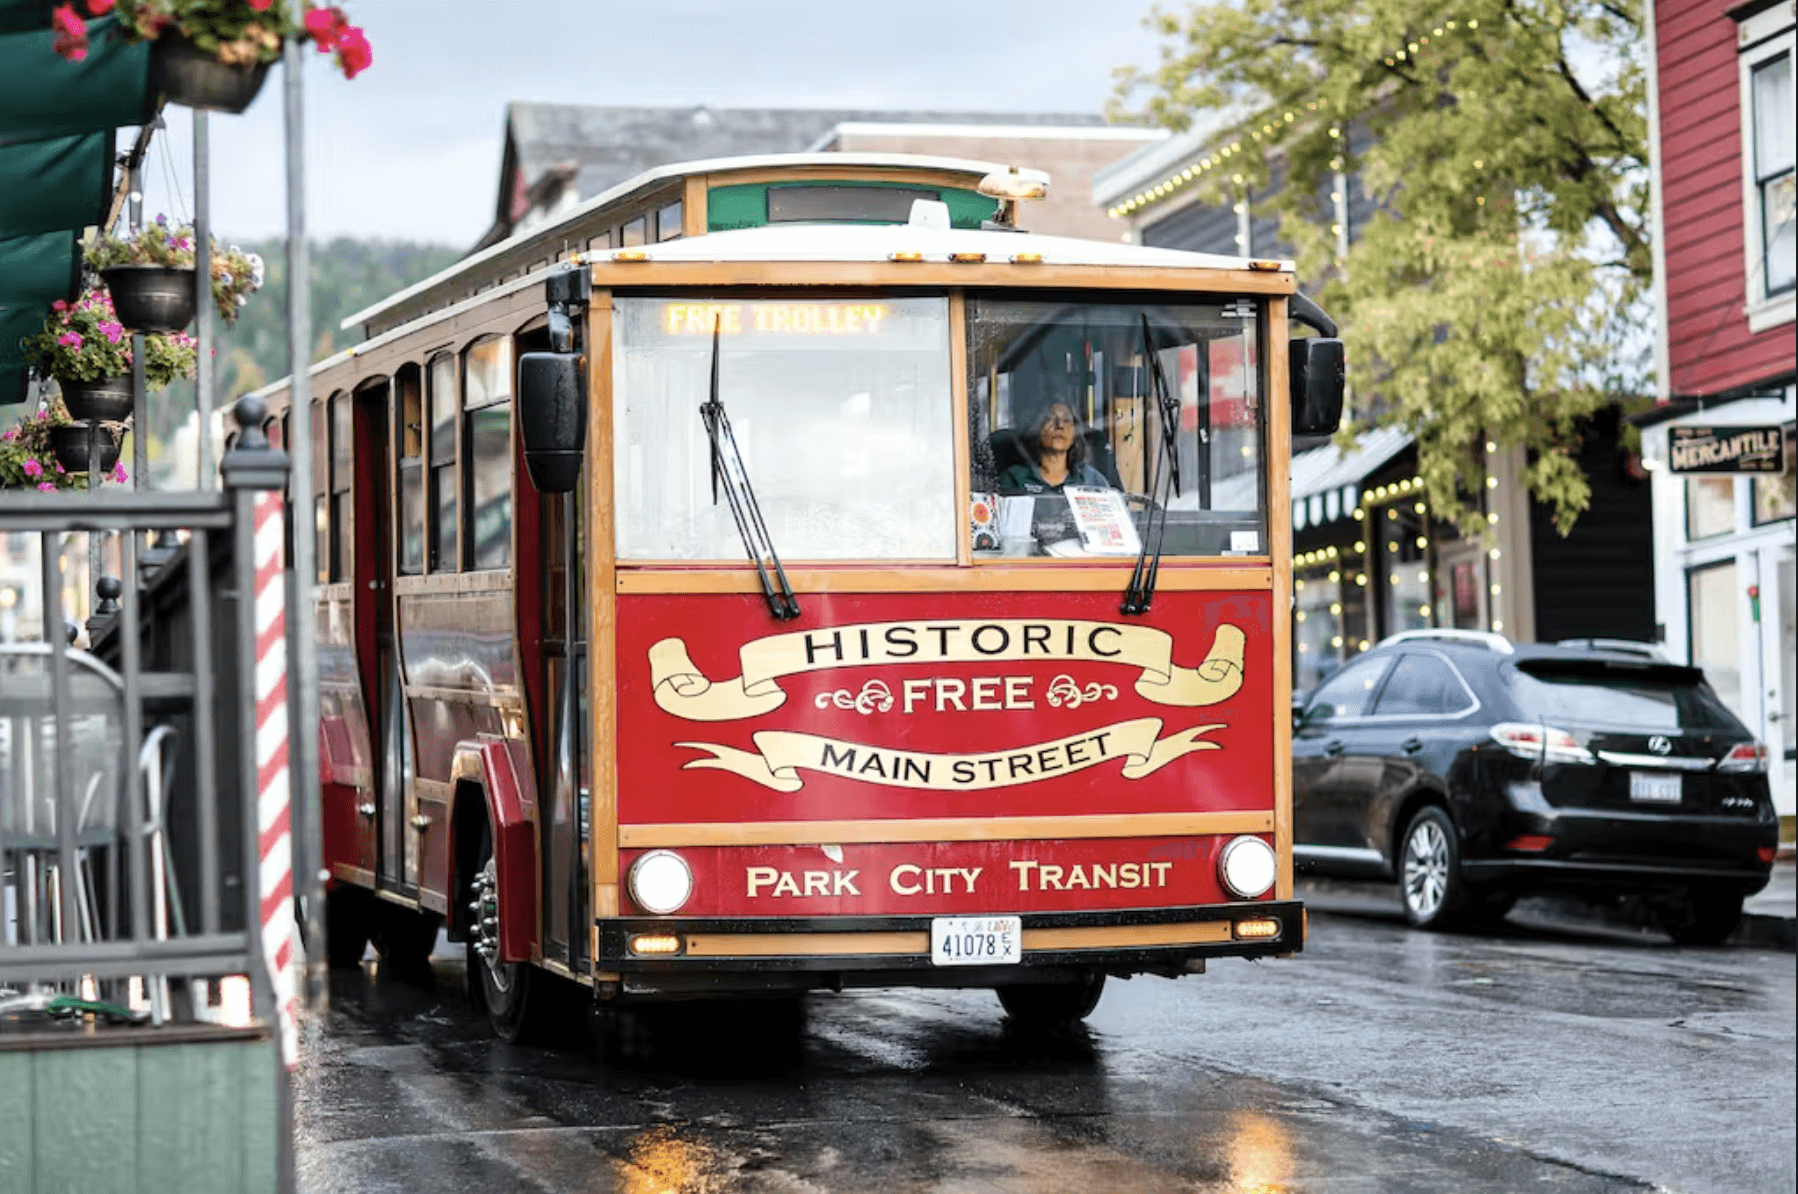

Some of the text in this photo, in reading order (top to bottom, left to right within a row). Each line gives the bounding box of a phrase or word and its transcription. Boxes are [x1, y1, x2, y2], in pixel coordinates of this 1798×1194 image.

[668, 304, 884, 333] FREE TROLLEY
[1672, 431, 1780, 470] MERCANTILE
[804, 624, 1123, 664] HISTORIC
[902, 675, 1035, 713] FREE
[820, 733, 1112, 784] MAIN STREET
[745, 860, 1173, 898] PARK CITY TRANSIT
[942, 934, 995, 957] 41078
